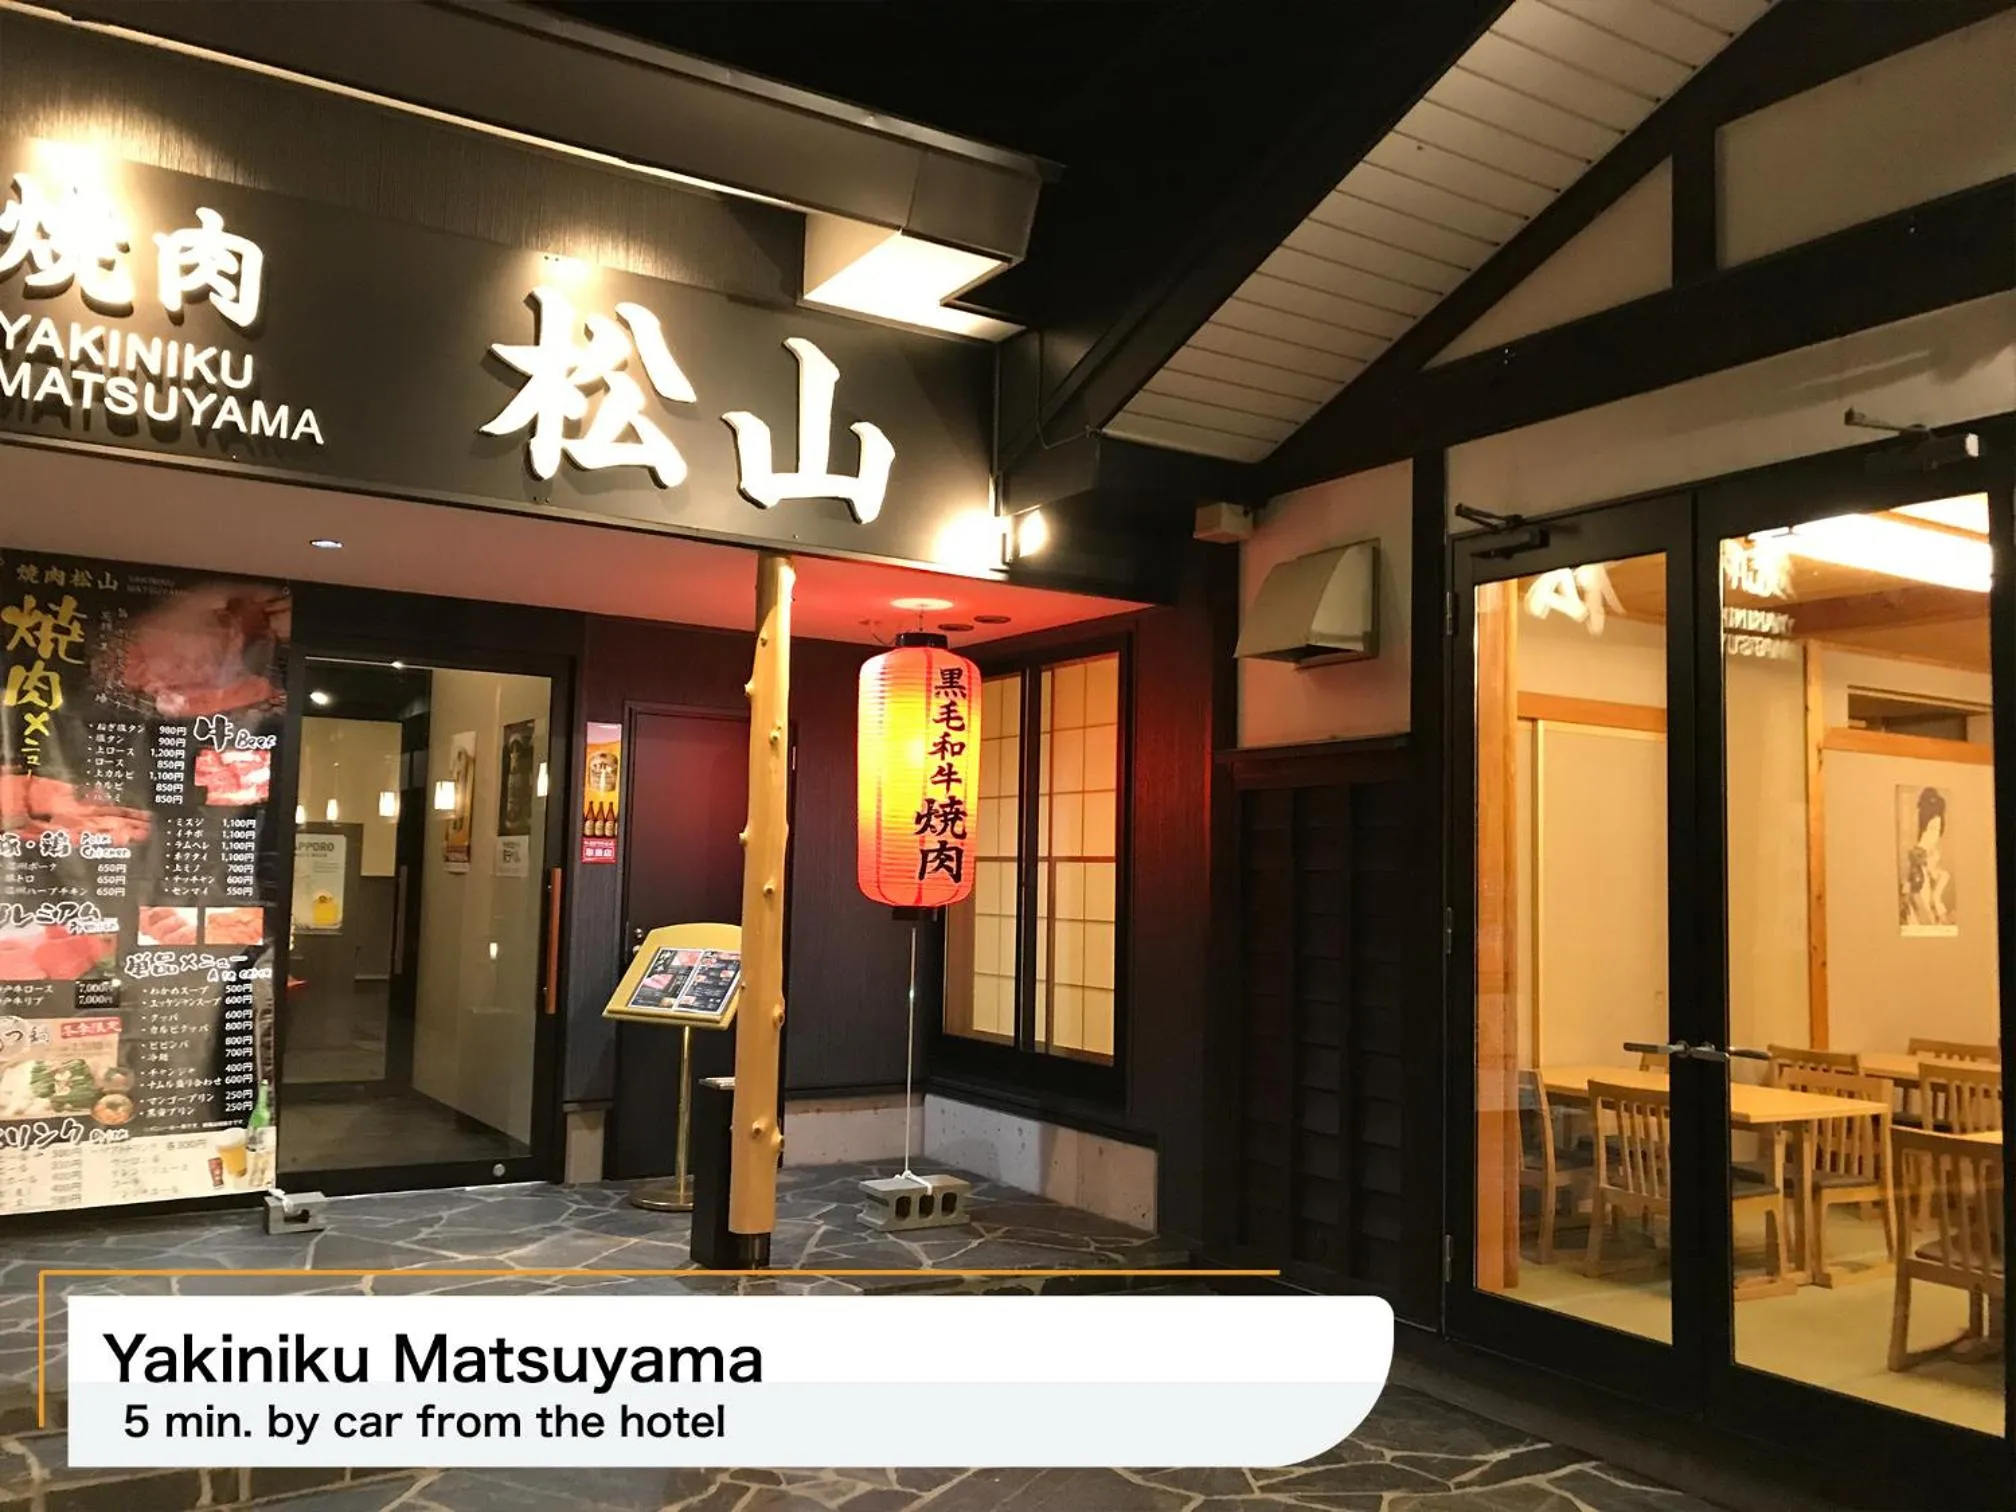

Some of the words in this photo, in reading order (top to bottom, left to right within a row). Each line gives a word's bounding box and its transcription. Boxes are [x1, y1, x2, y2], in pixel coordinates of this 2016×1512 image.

[0, 170, 264, 327] 焼肉
[0, 311, 254, 389] YAKINIKU
[0, 363, 325, 445] MATSUYAMA
[479, 285, 896, 525] 松山
[16, 563, 118, 591] 焼肉松山
[95, 746, 135, 756] 上ロース
[150, 748, 185, 759] 1,200円
[94, 758, 124, 767] ロース
[157, 760, 185, 770] 850円
[149, 771, 184, 781] 1,100円
[156, 783, 184, 793] 850円
[222, 818, 256, 829] 1,100円
[222, 830, 256, 840] 1,100円
[221, 841, 255, 851] 1,100円
[221, 852, 255, 862] 1,100円
[227, 864, 254, 873] 700円
[226, 875, 254, 885] 600円
[226, 886, 254, 897] 550円
[225, 983, 253, 993] 500円
[225, 994, 253, 1005] 600円
[225, 1009, 253, 1019] 600円
[225, 1047, 253, 1057] 700円
[225, 1062, 253, 1072] 400円
[225, 1073, 253, 1084] 600円
[225, 1089, 253, 1100] 250円
[225, 1101, 253, 1111] 250円
